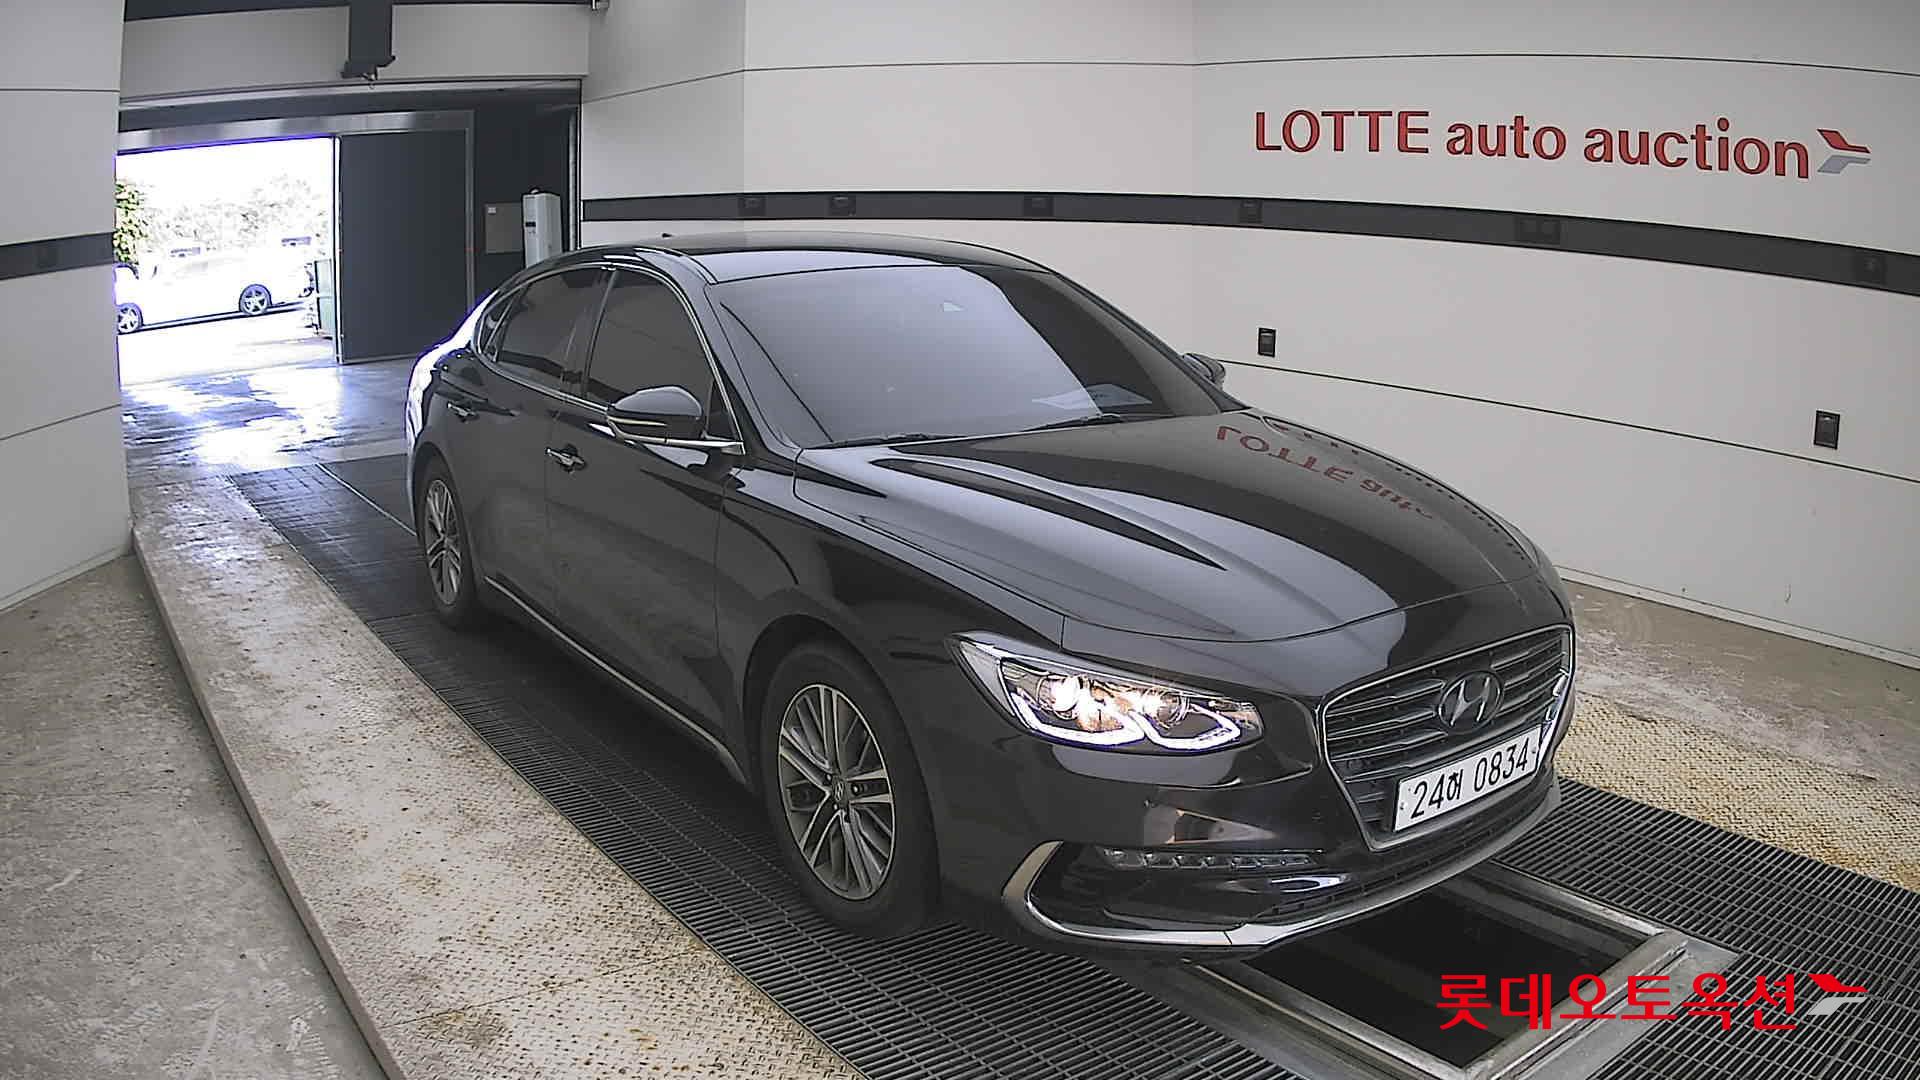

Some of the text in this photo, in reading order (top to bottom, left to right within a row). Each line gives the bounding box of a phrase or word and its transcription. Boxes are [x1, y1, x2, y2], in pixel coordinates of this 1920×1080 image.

[1255, 110, 1810, 179] LOTTE auto auction
[1411, 737, 1530, 819] 24허 0834
